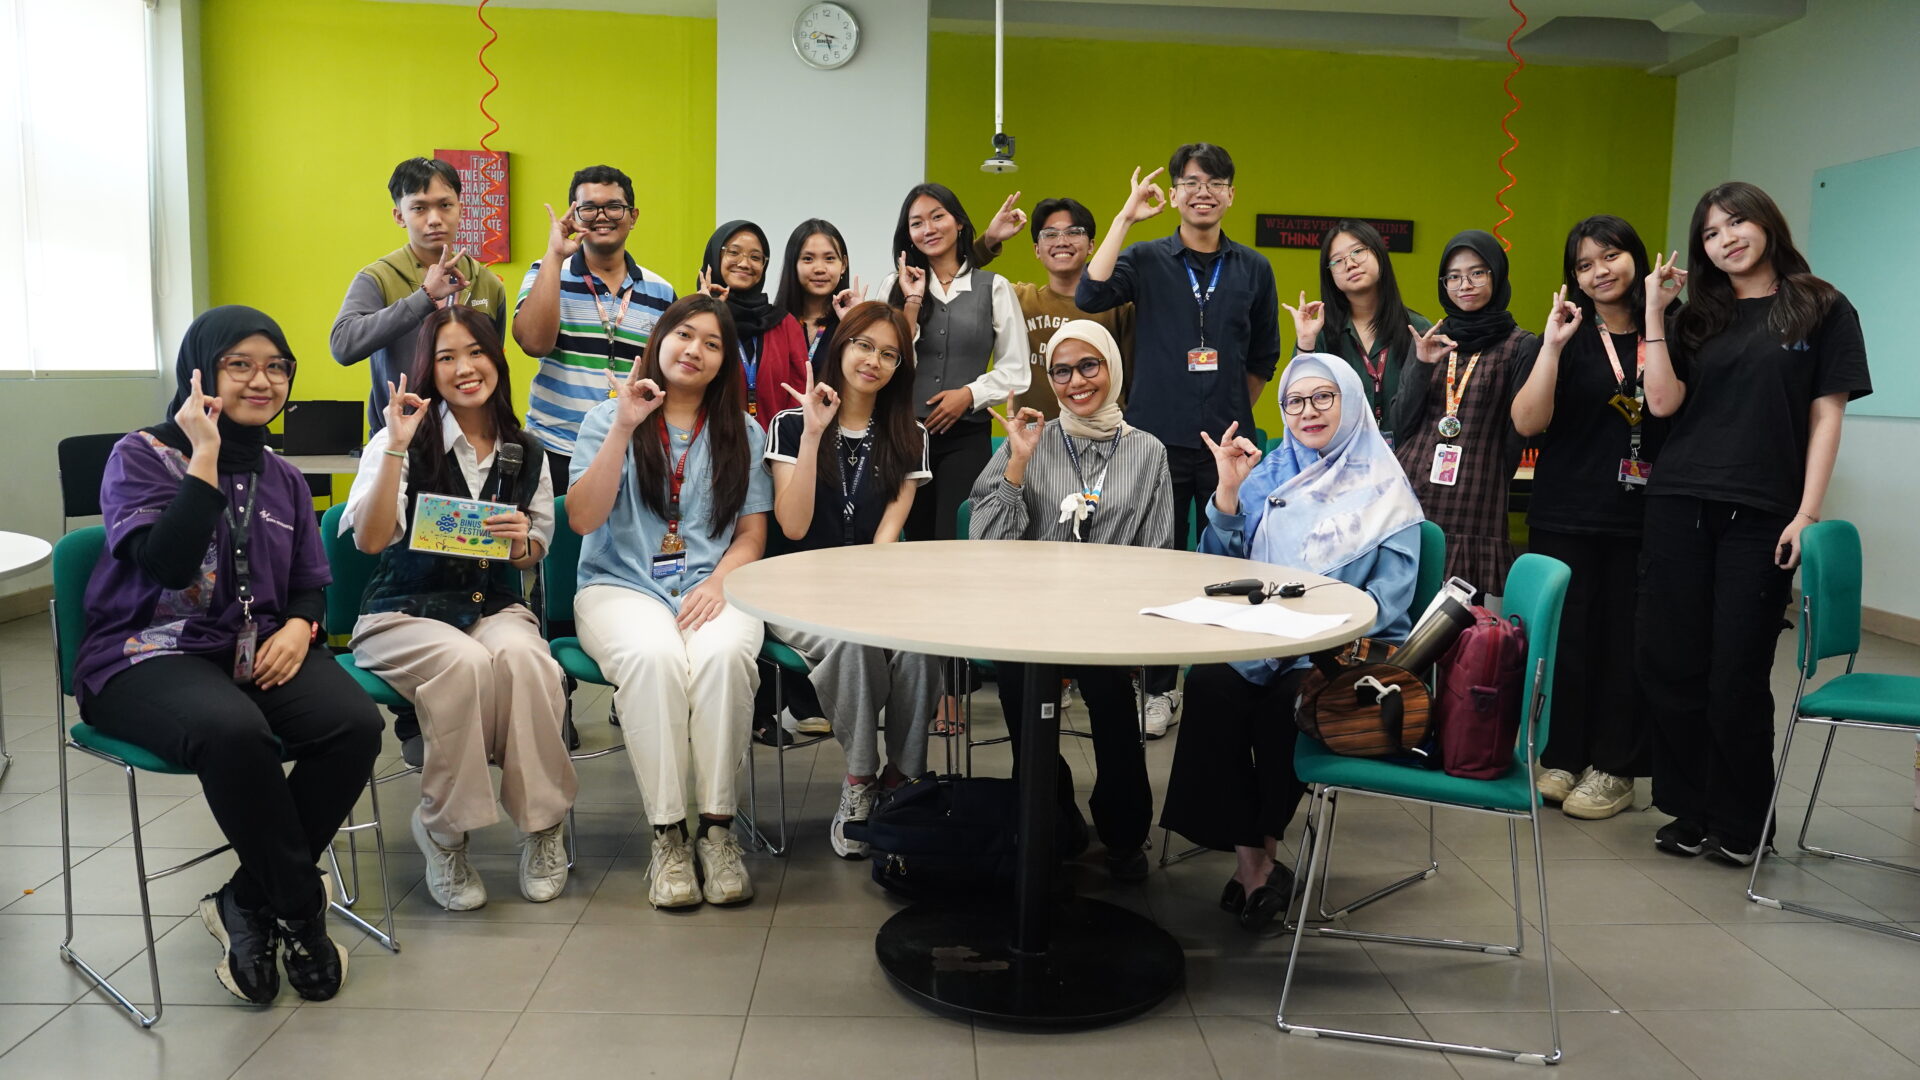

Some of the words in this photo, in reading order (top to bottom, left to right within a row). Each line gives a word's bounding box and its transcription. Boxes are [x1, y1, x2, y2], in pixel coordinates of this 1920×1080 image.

[822, 9, 831, 18] 12
[456, 169, 505, 183] TNERSHIP
[461, 182, 491, 194] SHARE
[457, 219, 502, 231] ABORATE
[1264, 217, 1337, 231] WHATEVER
[1280, 231, 1320, 247] THINK
[1026, 314, 1069, 332] NTAGE
[459, 518, 482, 529] BINUS
[458, 526, 492, 538] FESTIVAL
